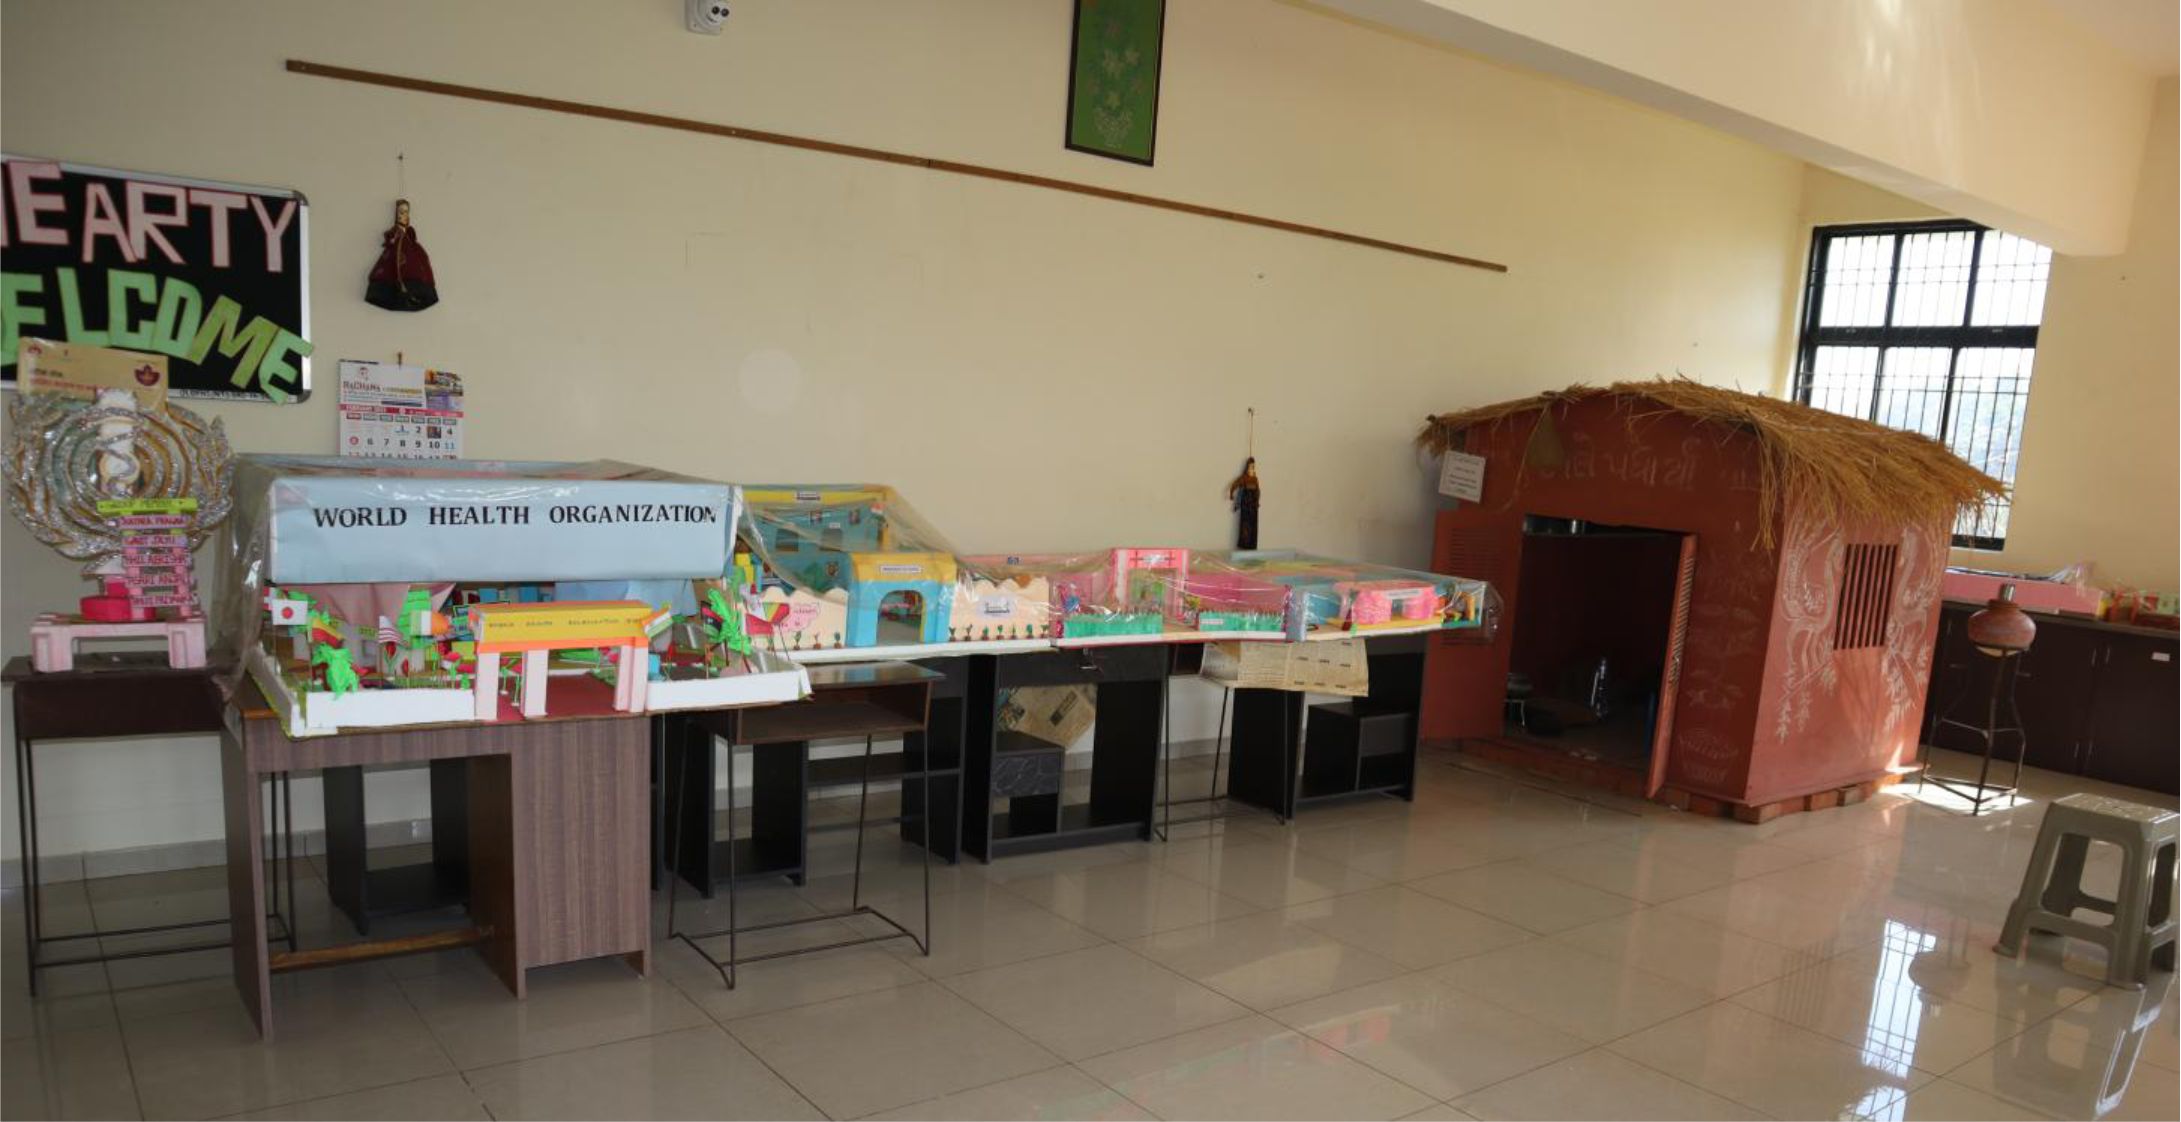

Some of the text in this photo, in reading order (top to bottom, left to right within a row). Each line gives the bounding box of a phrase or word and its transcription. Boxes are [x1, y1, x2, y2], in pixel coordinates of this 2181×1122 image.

[0, 160, 298, 273] EARTY
[429, 441, 440, 449] 10
[313, 504, 717, 528] WORLD HEALTH ORGANIZATION
